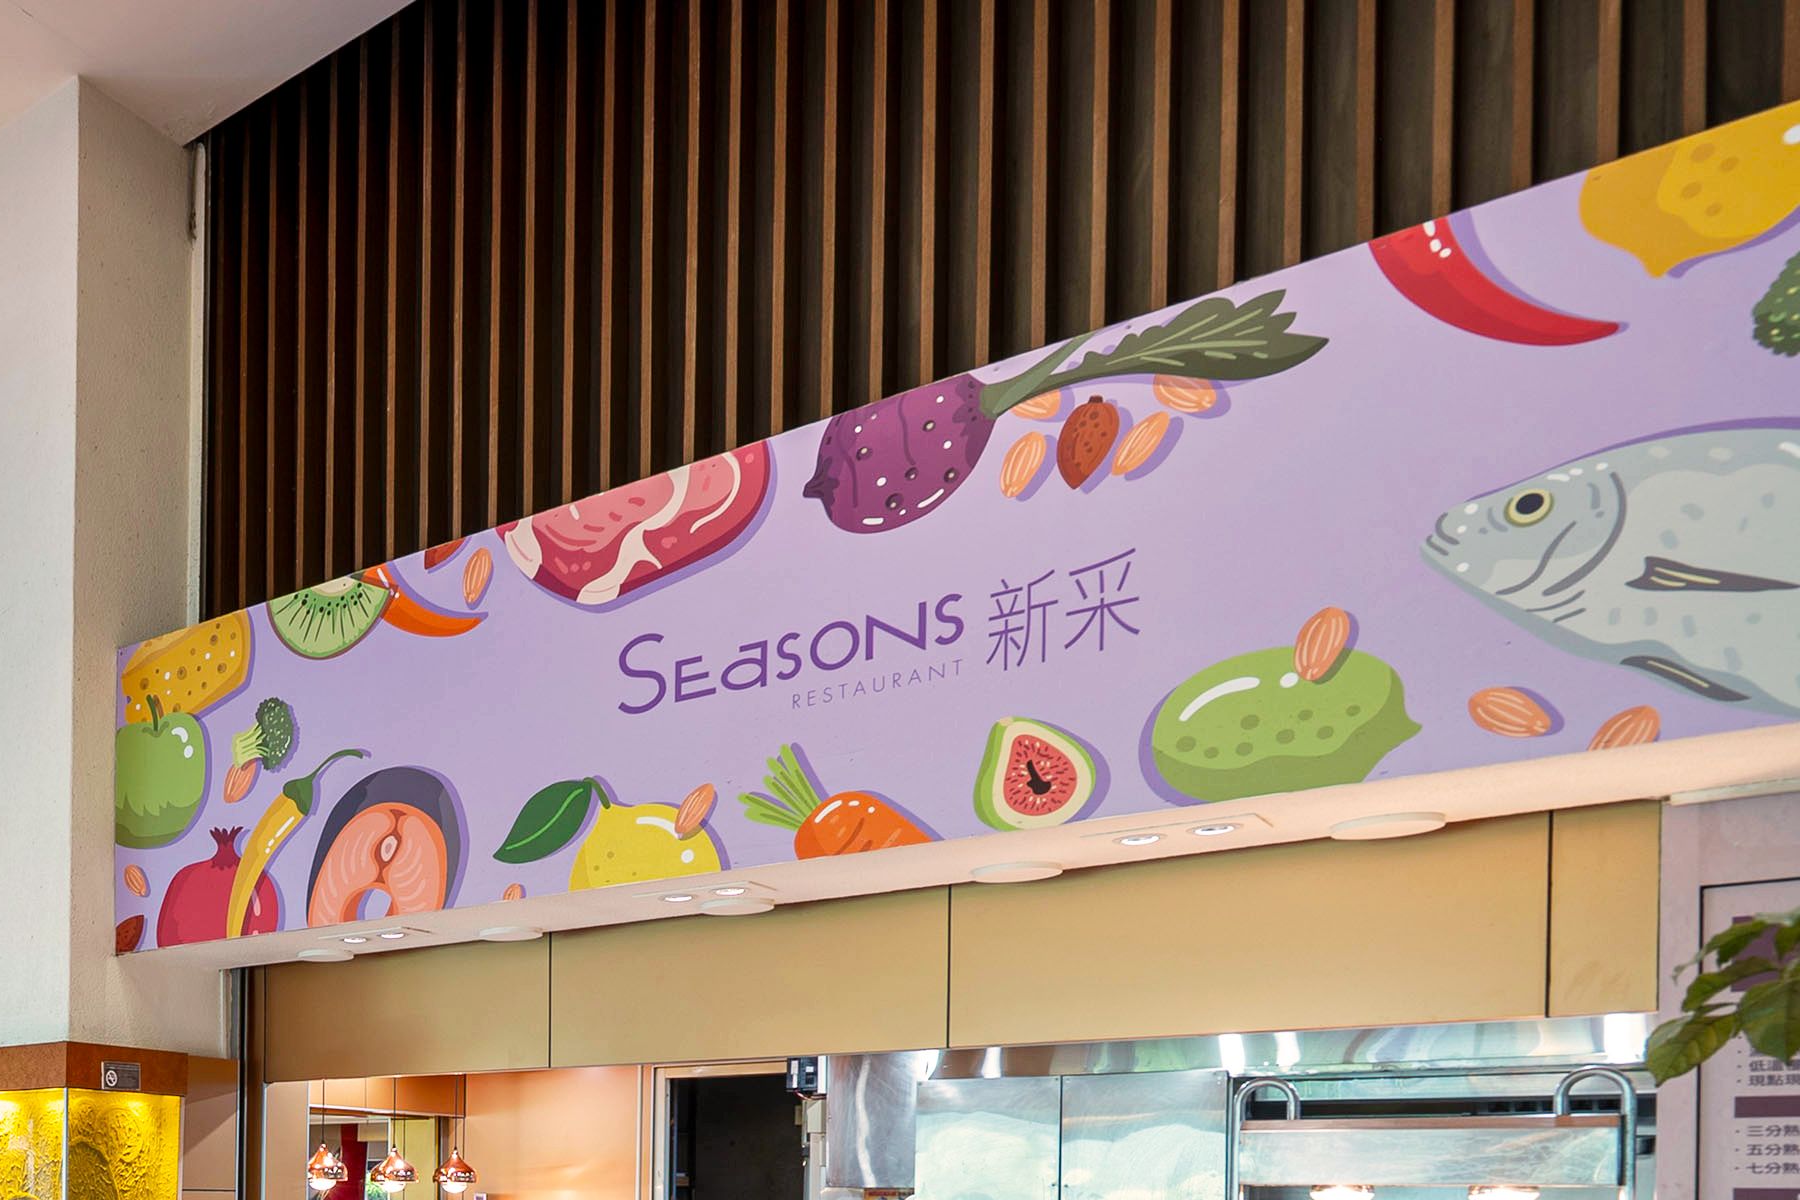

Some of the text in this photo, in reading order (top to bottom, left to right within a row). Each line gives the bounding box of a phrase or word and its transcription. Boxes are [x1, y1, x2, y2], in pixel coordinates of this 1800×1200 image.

[985, 547, 1141, 672] 新采
[791, 658, 964, 710] RESTAURANT
[1745, 1124, 1800, 1137] 三分熟
[1745, 1143, 1800, 1156] 五分熟
[1745, 1161, 1800, 1174] 七分熟
